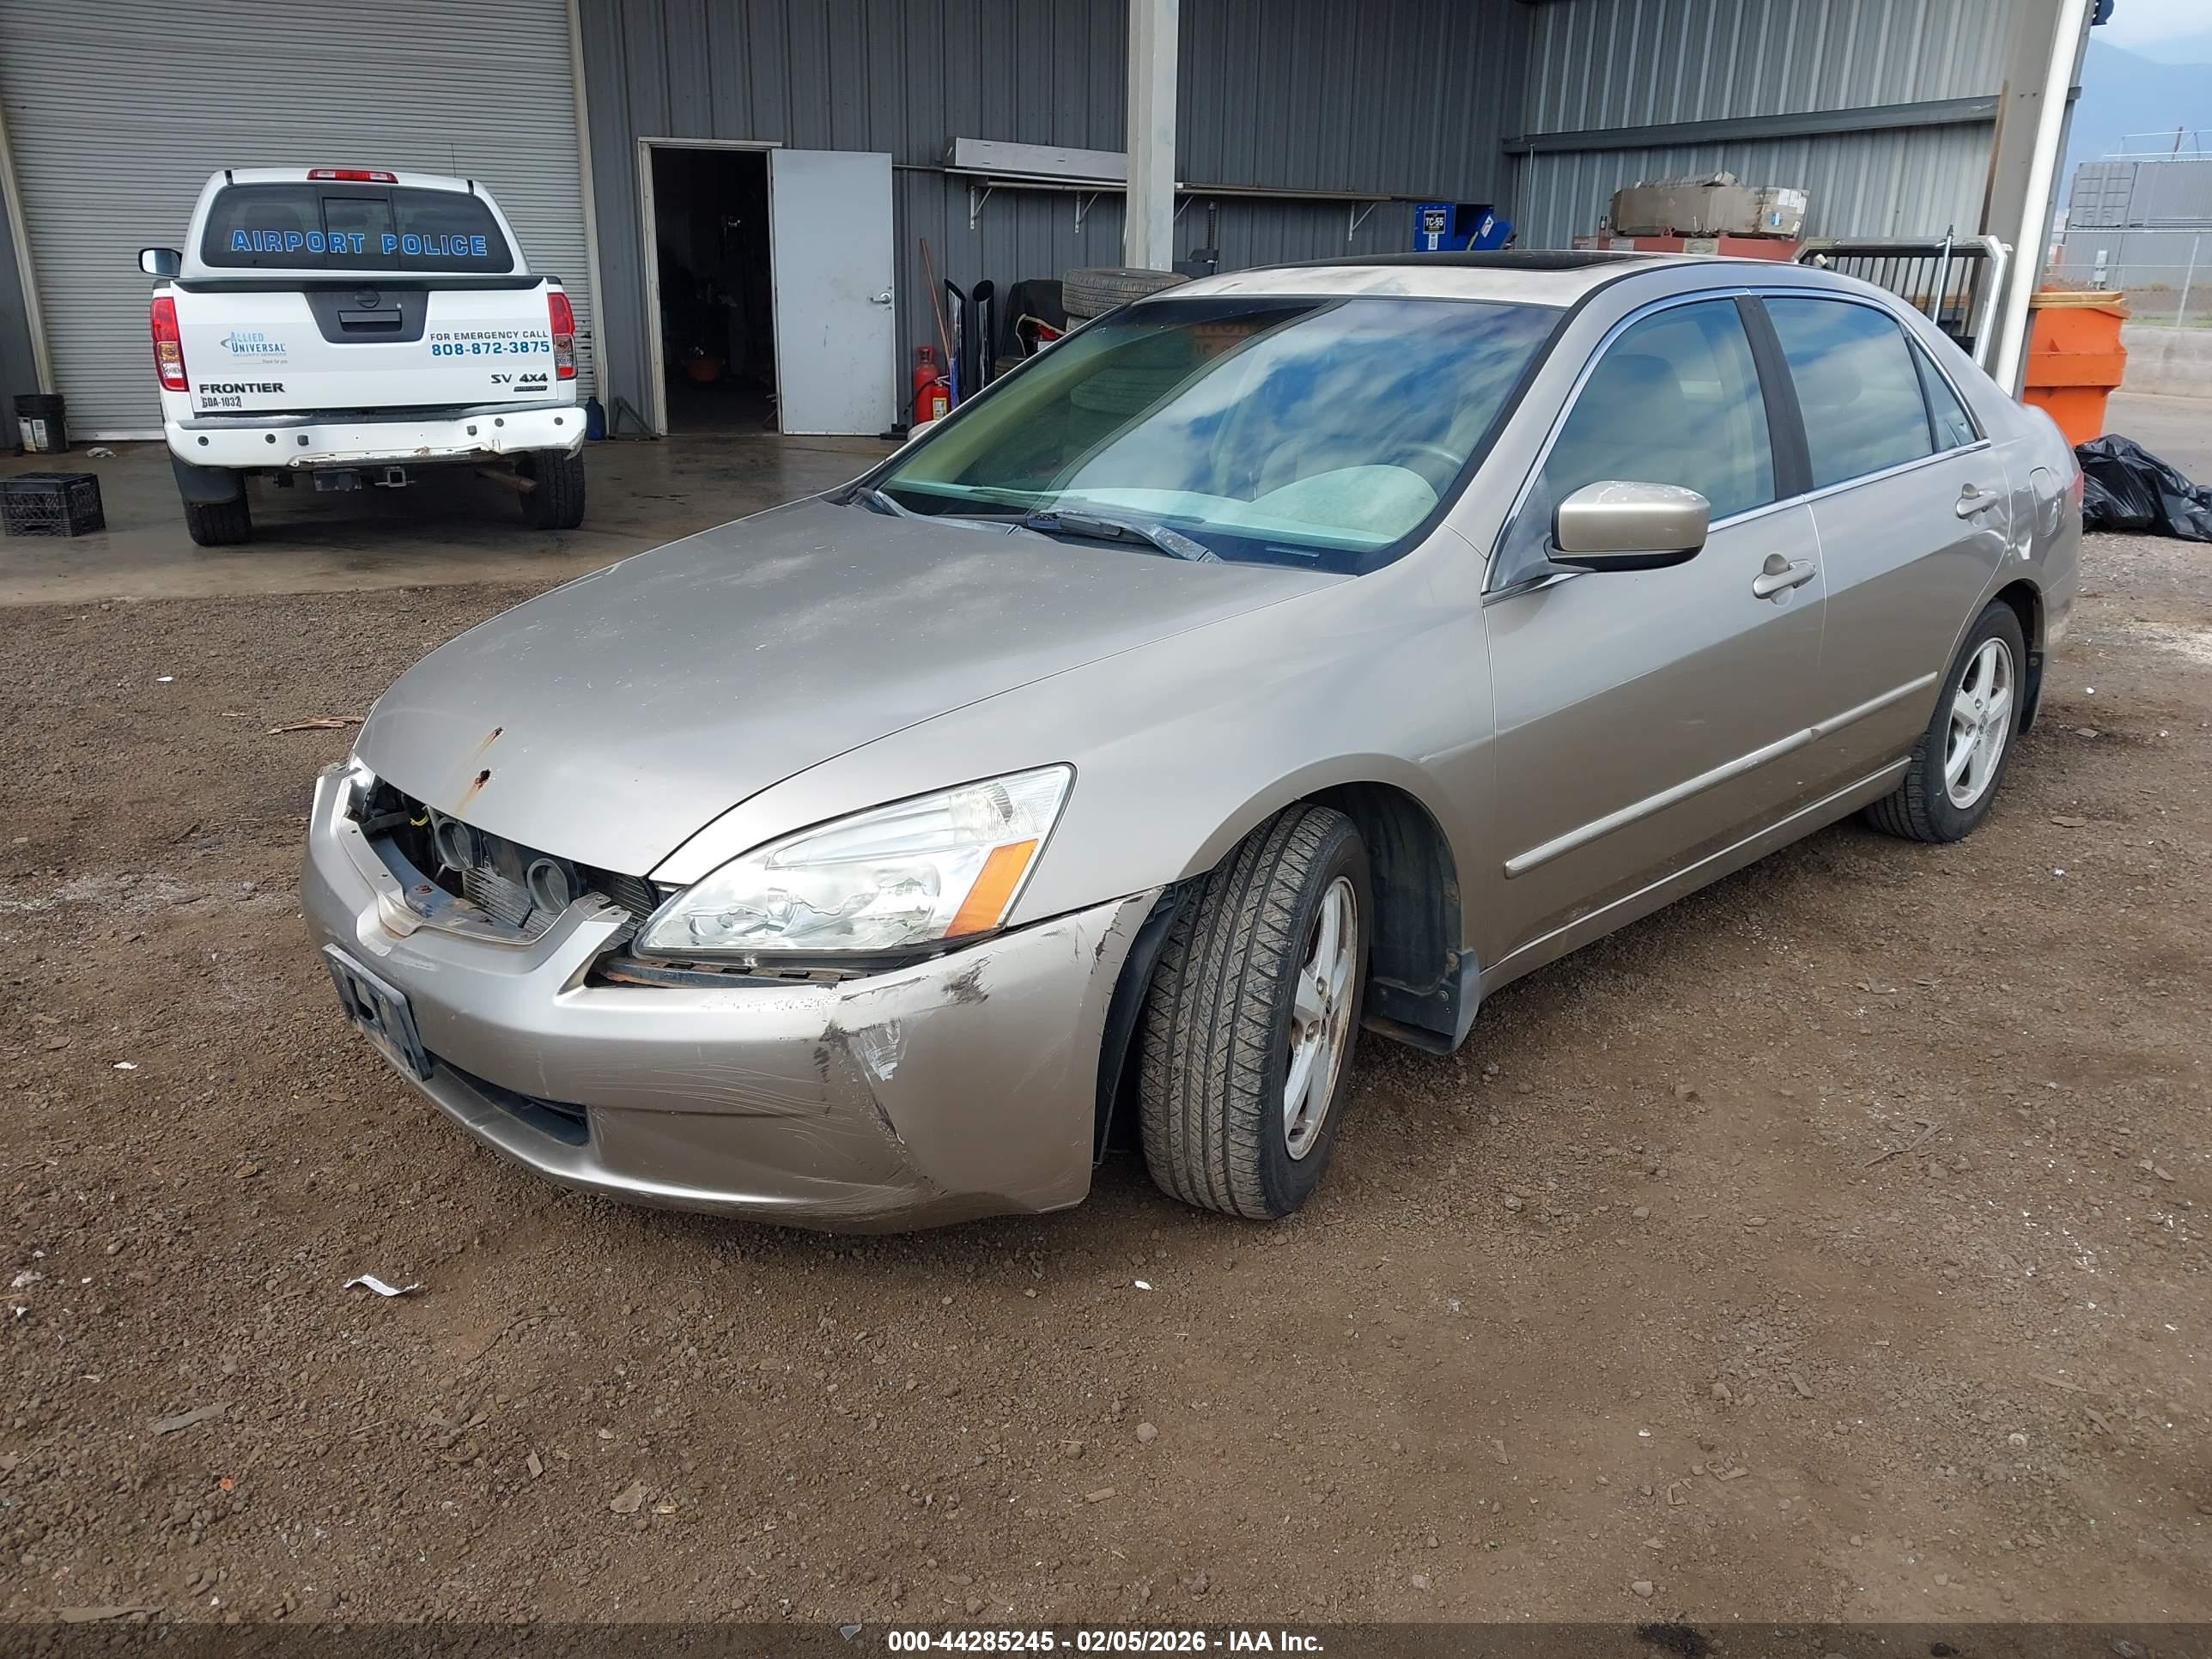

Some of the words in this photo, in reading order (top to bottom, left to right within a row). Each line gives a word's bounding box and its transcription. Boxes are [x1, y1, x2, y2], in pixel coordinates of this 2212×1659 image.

[1425, 217, 1443, 226] TC-55
[231, 230, 365, 253] AIRPORT
[382, 234, 488, 255] POLICE
[230, 331, 264, 343] ALLIED
[453, 331, 520, 340] EMERGENCY
[522, 330, 549, 338] CALL
[232, 343, 285, 353] UNIVERSAL
[432, 341, 550, 356] 808-872-3875
[490, 374, 513, 384] SV
[198, 383, 285, 393] FRONTIER
